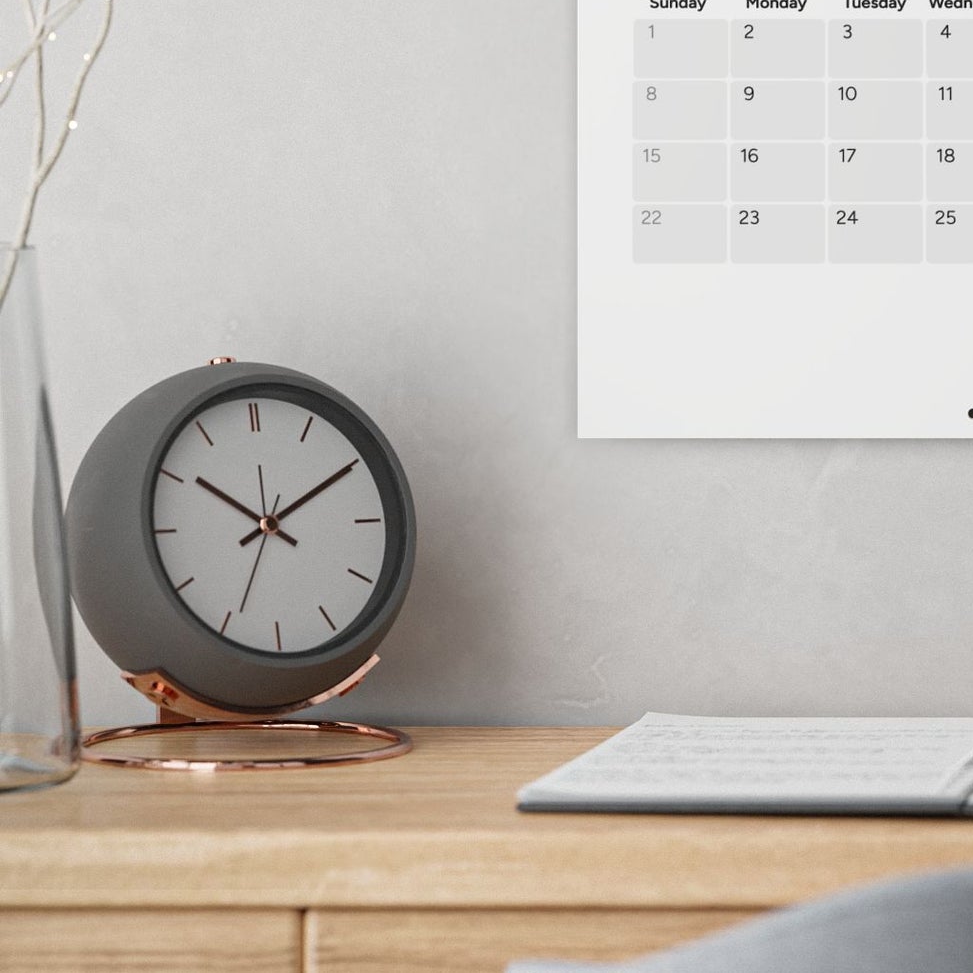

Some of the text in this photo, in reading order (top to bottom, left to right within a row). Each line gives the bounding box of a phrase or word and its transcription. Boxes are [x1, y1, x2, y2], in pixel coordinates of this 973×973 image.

[647, 23, 656, 40] 1
[743, 23, 755, 40] 2
[842, 23, 853, 40] 3
[939, 23, 952, 40] 4
[645, 85, 658, 102] 8
[743, 85, 755, 102] 9
[837, 85, 858, 102] 10
[938, 85, 954, 102] 11
[641, 147, 662, 164] 15
[739, 147, 760, 164] 16
[838, 147, 857, 164] 17
[936, 147, 956, 164] 18
[640, 209, 662, 226] 22
[738, 209, 760, 226] 23
[835, 209, 860, 226] 24
[934, 209, 957, 226] 25
